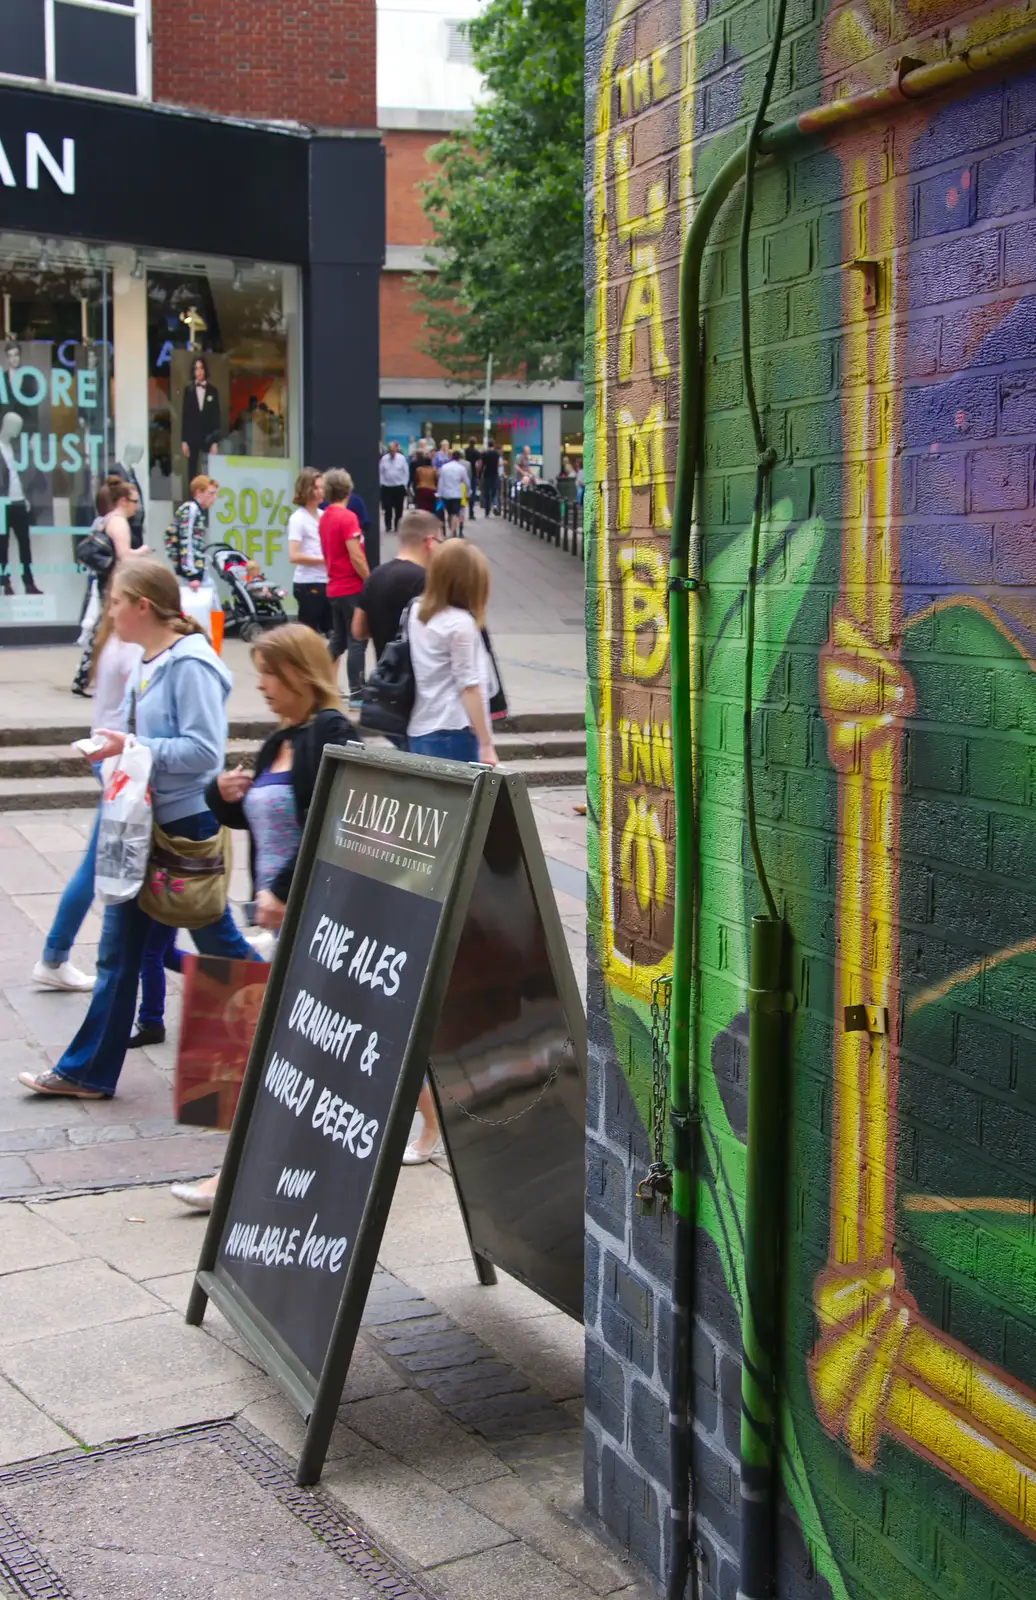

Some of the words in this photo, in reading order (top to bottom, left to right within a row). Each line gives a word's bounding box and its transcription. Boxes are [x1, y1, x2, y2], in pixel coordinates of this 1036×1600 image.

[615, 42, 670, 116] THE
[612, 133, 673, 680] LAMB
[12, 432, 104, 473] JUST
[216, 487, 292, 526] 30%
[617, 716, 674, 788] INN
[340, 788, 400, 834] LAMB
[398, 802, 449, 848] INN
[335, 835, 380, 859] TRADITIONAL
[380, 850, 396, 863] PUB
[401, 857, 433, 875] DINING
[308, 914, 355, 973] FINE
[348, 936, 408, 996] ALES
[288, 989, 363, 1063] DRAUGHT
[360, 1031, 381, 1077] &
[264, 1051, 316, 1117] WORLD
[312, 1086, 379, 1159] BEERS
[224, 1222, 301, 1267] AVAILABLE
[299, 1212, 348, 1273] here
